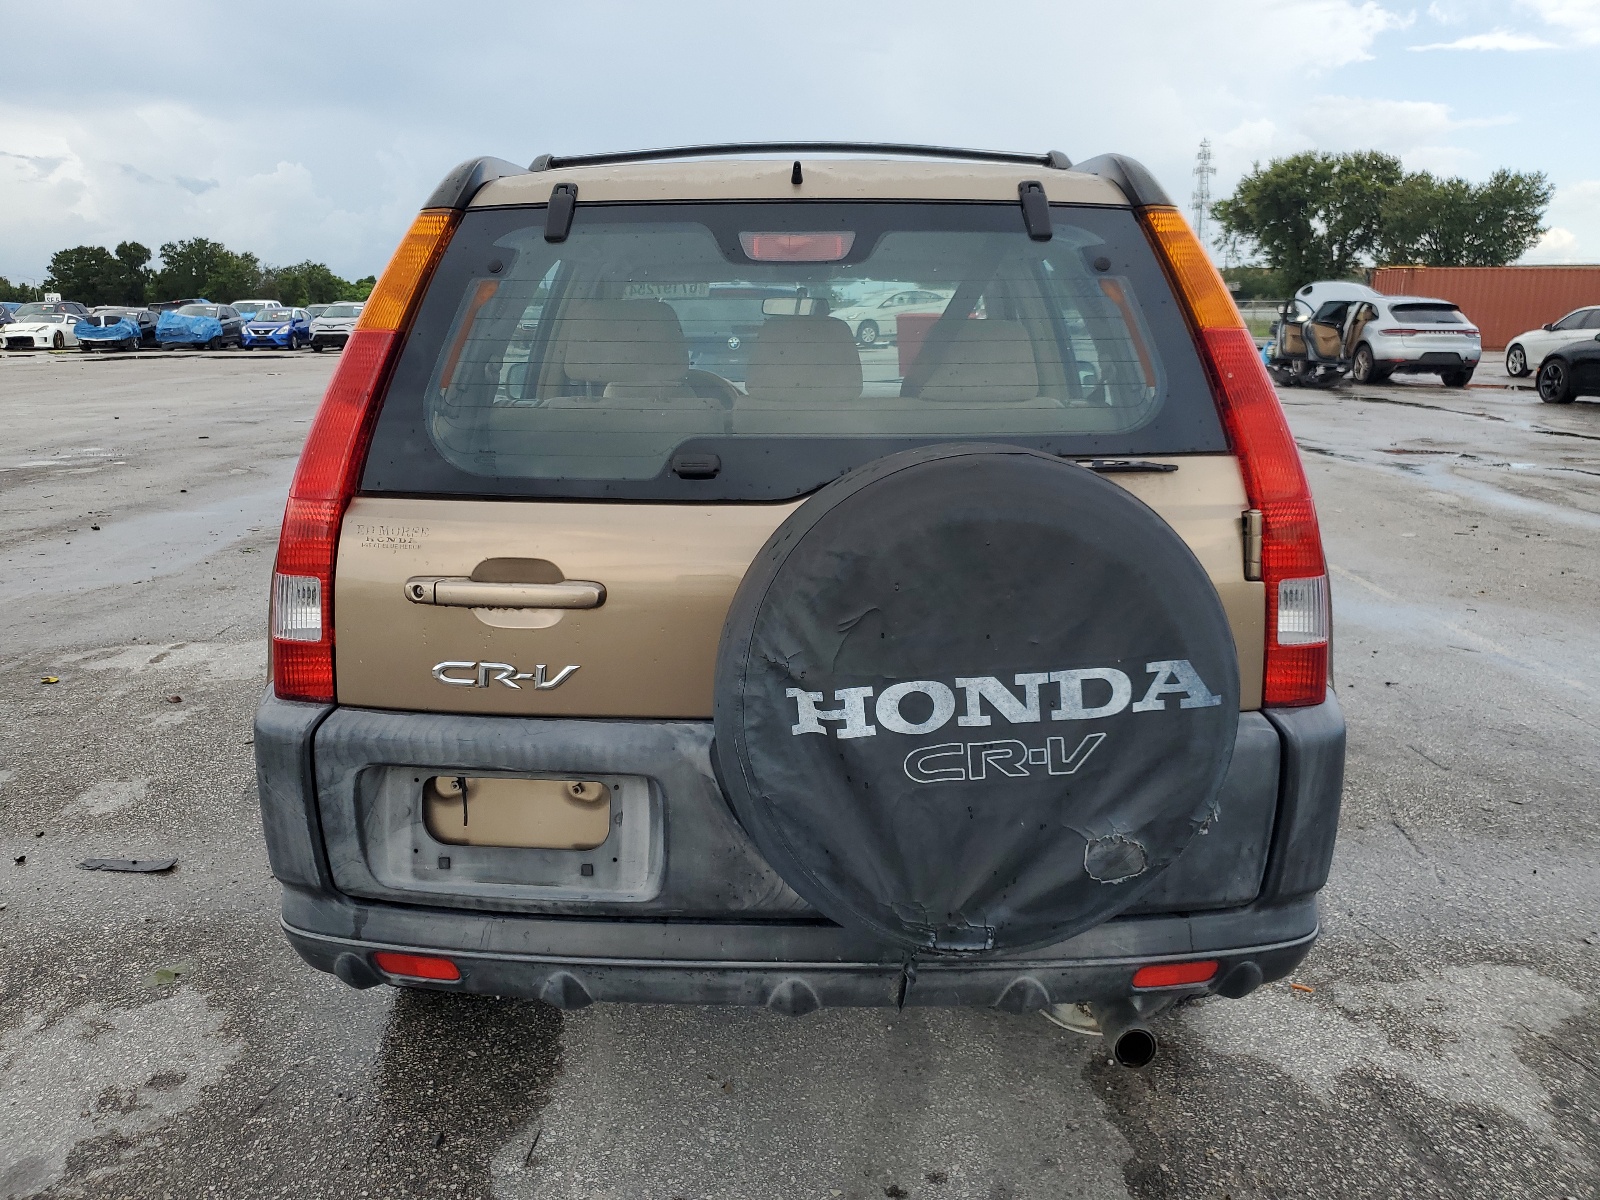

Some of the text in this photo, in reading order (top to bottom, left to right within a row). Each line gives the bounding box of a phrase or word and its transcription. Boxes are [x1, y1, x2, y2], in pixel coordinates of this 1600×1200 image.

[432, 660, 581, 690] CR-V
[786, 659, 1222, 739] HONDA
[904, 732, 1106, 784] CR-V
